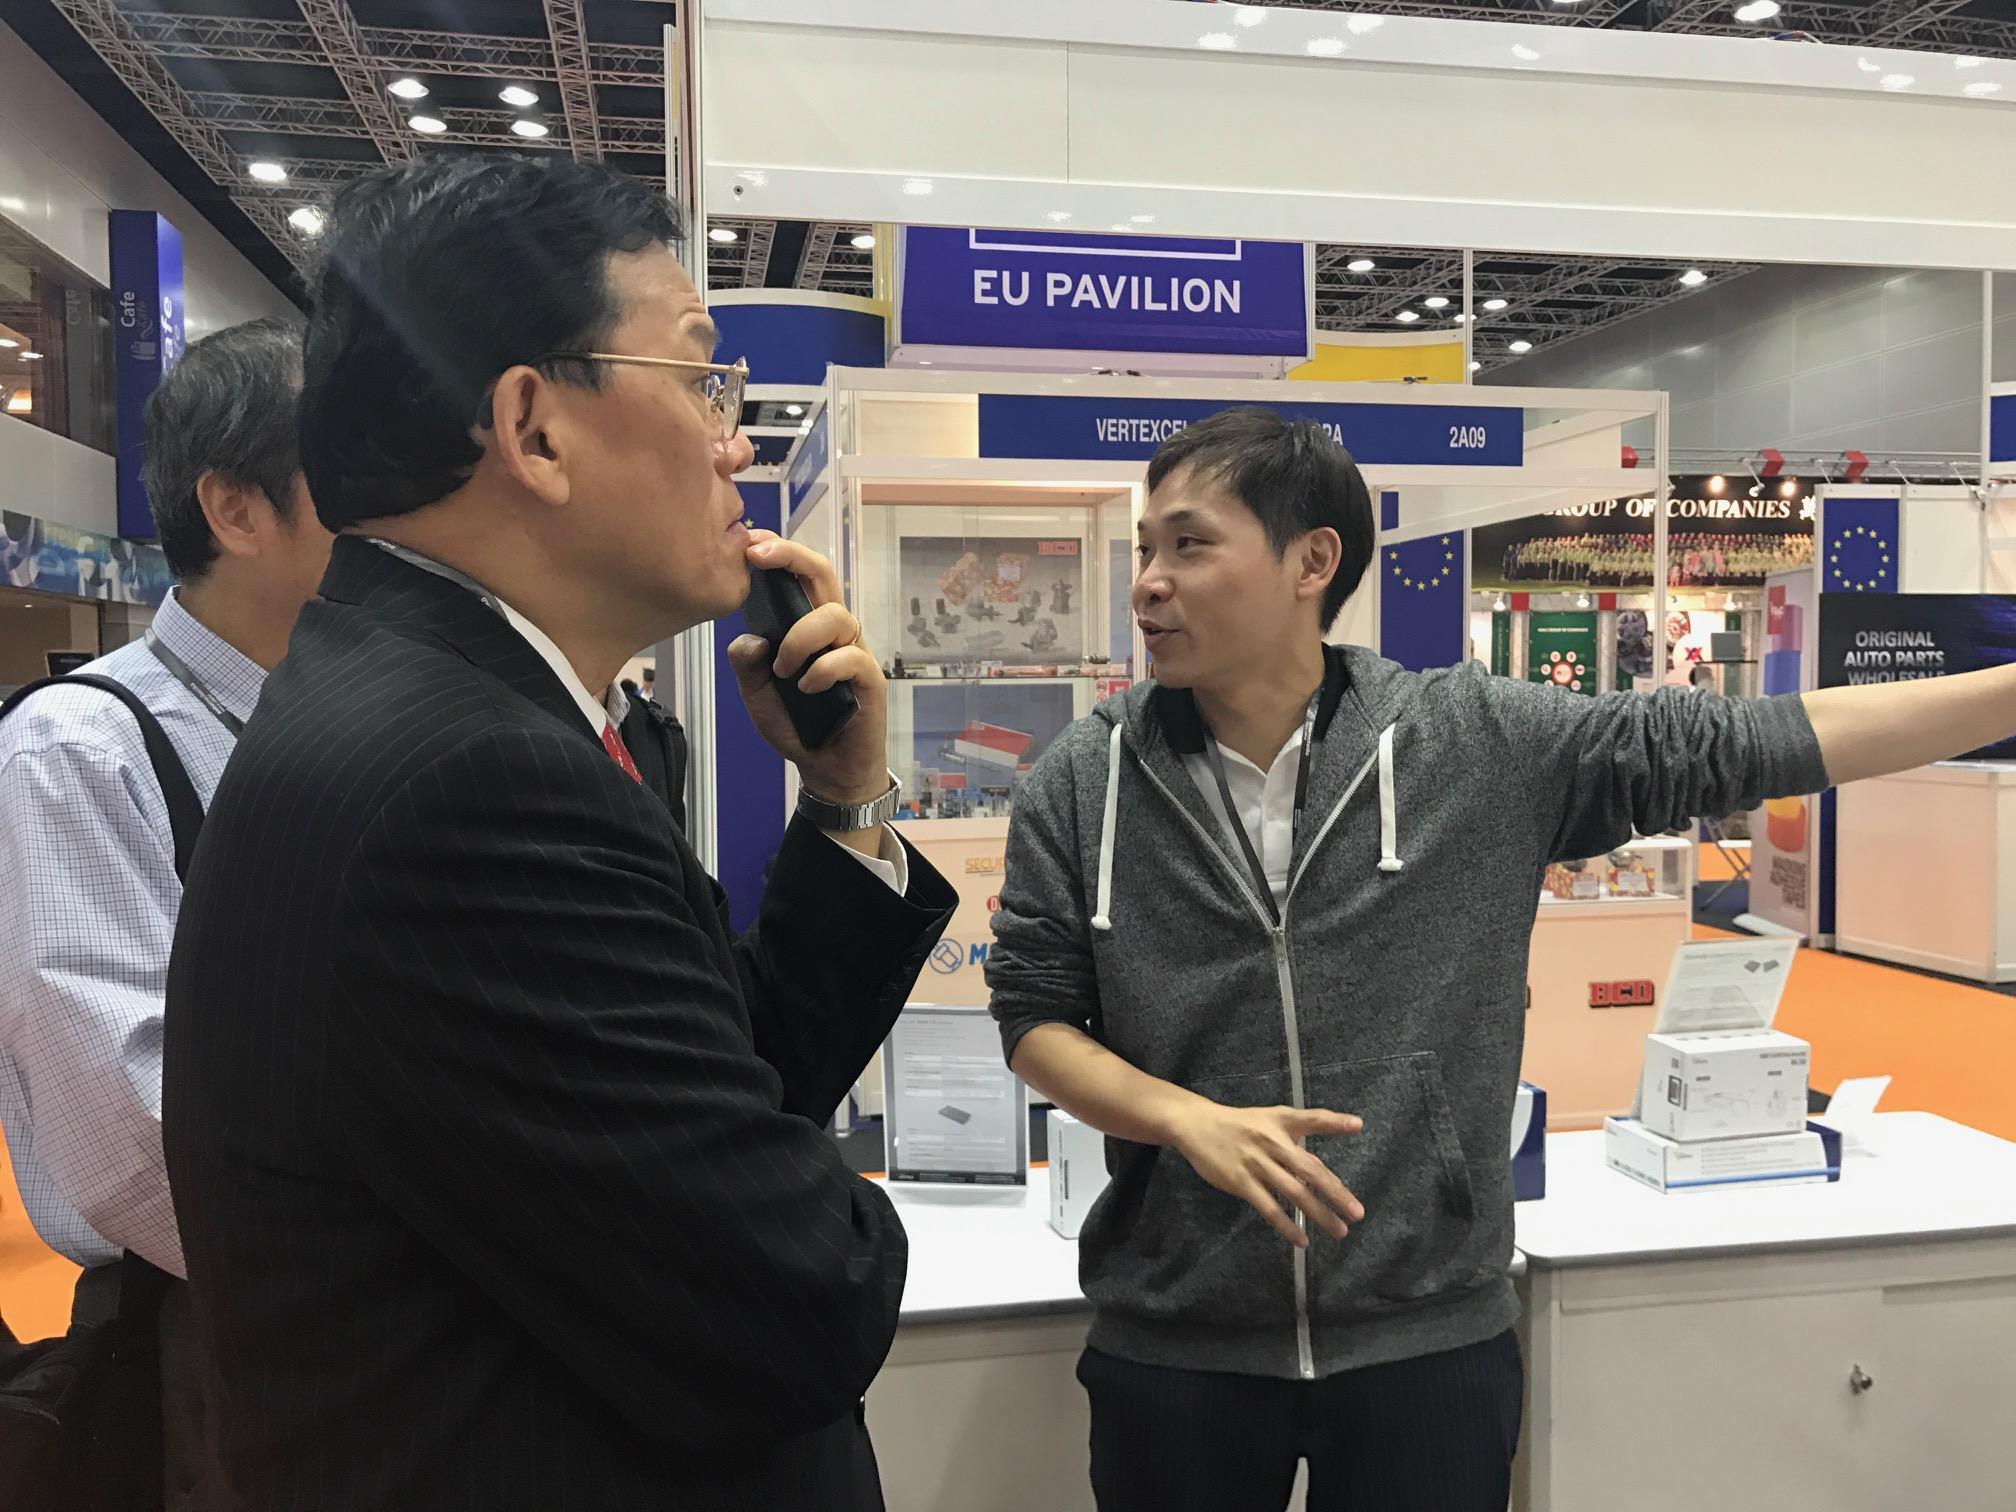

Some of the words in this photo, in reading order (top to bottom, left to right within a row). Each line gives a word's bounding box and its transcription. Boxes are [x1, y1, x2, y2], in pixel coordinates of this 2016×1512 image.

[974, 269, 1029, 306] EU
[1046, 272, 1241, 314] PAVILION
[120, 291, 135, 328] Cafe
[1449, 426, 1486, 448] 2A09
[1542, 499, 1618, 517] ROUP
[1625, 499, 1657, 518] OF
[1666, 499, 1791, 519] COMPANIES
[1855, 630, 1935, 648] ORIGINAL
[1844, 650, 1891, 667] AUTO
[1895, 650, 1945, 668] PARTS
